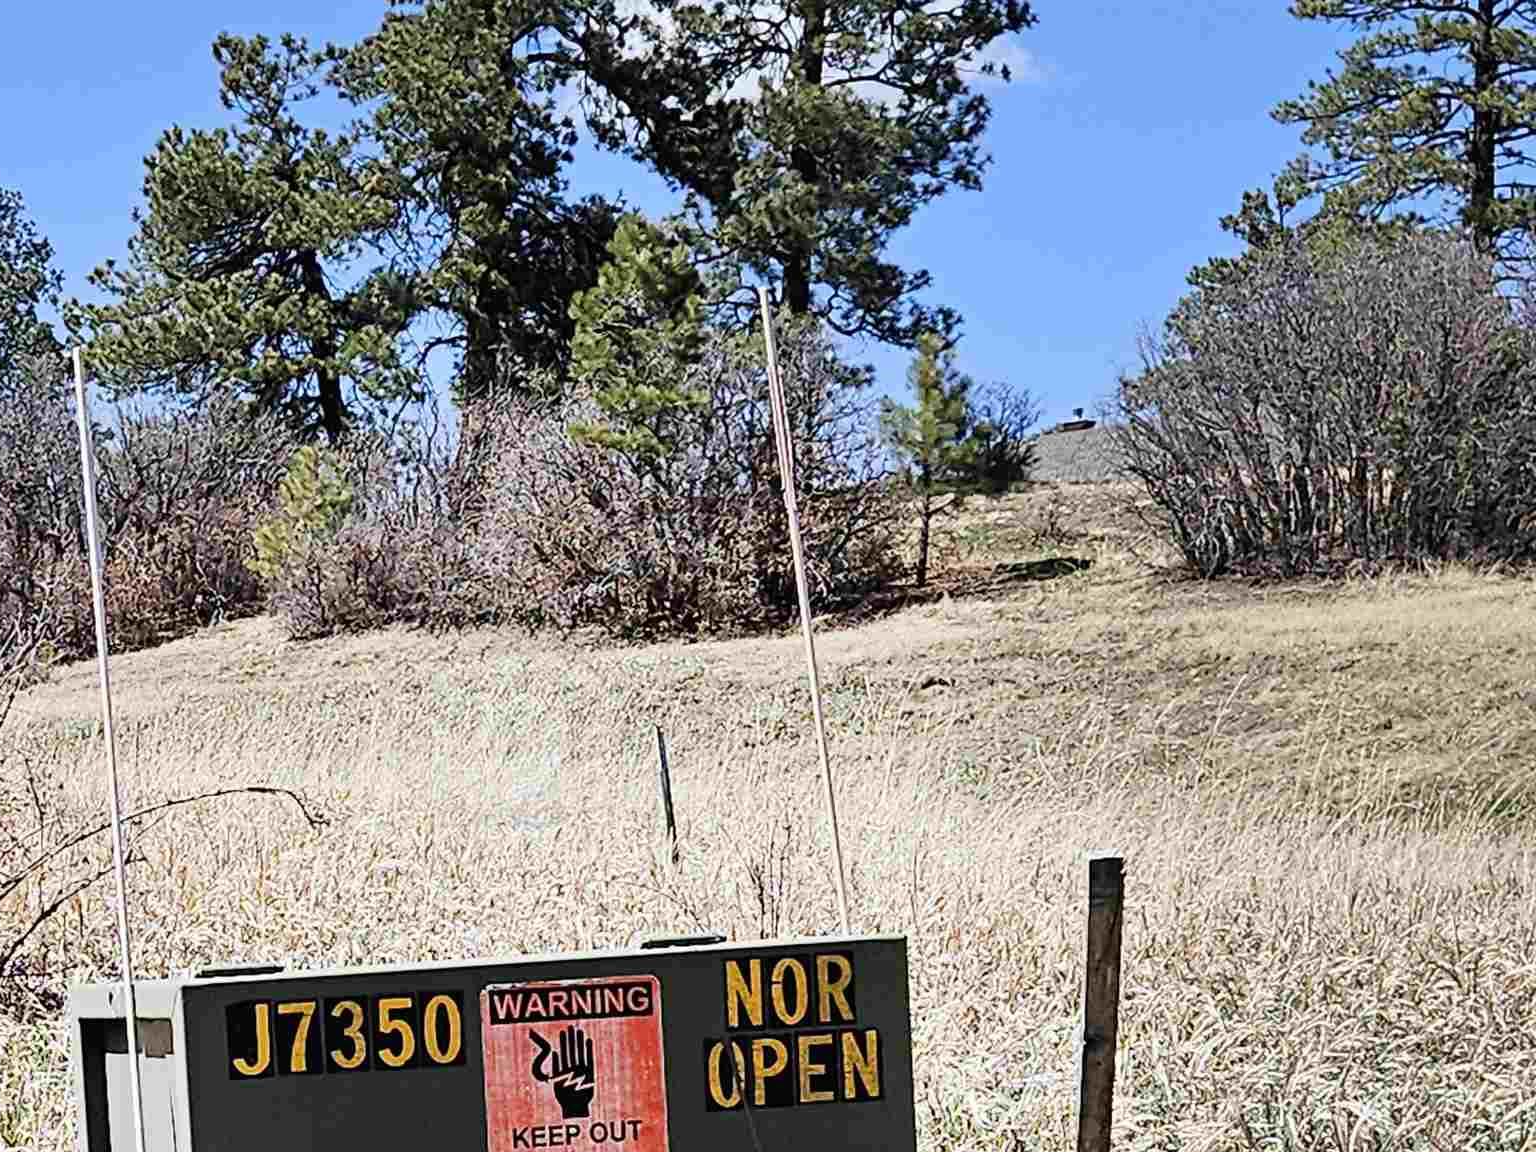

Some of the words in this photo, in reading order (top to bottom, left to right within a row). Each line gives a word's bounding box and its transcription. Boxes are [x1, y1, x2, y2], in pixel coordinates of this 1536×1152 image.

[493, 986, 650, 1020] WARNING
[726, 954, 854, 1027] NOR
[232, 994, 461, 1074] J7350
[708, 1029, 880, 1107] OPEN
[512, 1124, 580, 1149] KEEP
[590, 1120, 643, 1143] OUT
